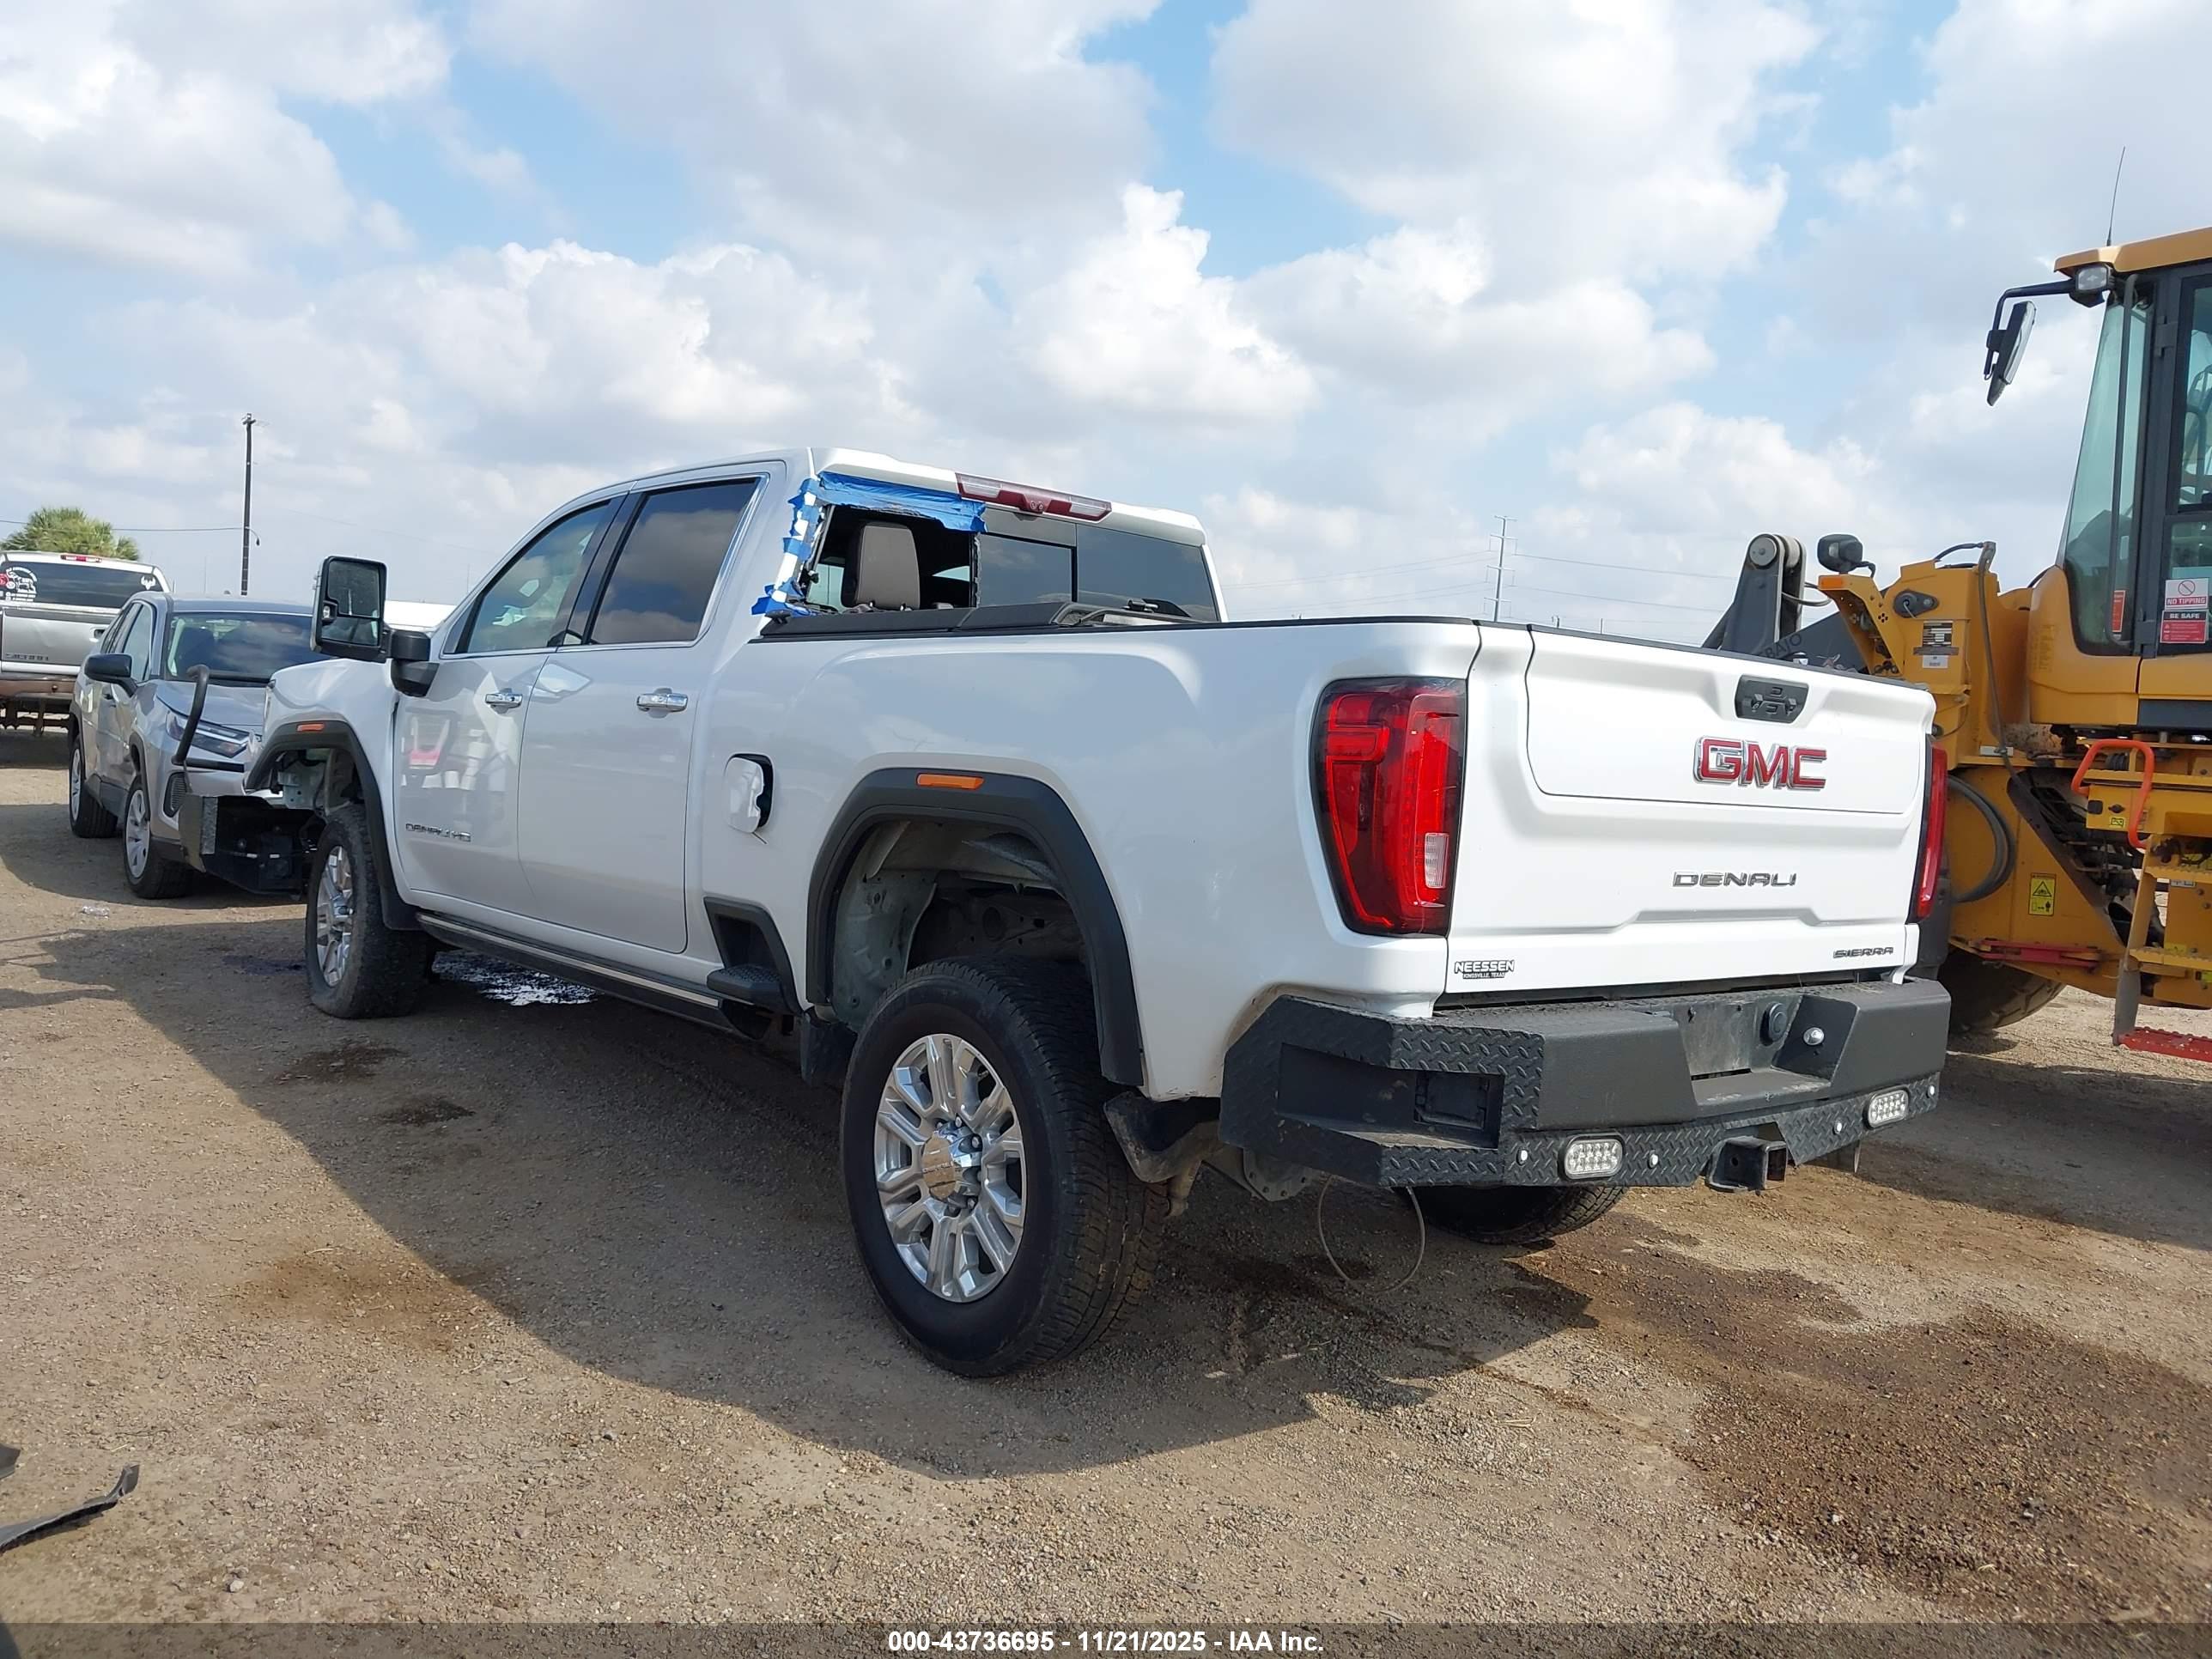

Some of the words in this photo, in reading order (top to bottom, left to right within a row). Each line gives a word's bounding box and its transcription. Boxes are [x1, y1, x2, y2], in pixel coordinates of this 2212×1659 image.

[1693, 736, 1827, 792] GMC
[1673, 872, 1797, 887] DENALI
[1833, 946, 1894, 958] SIERRA
[1454, 959, 1515, 974] NEESSEN
